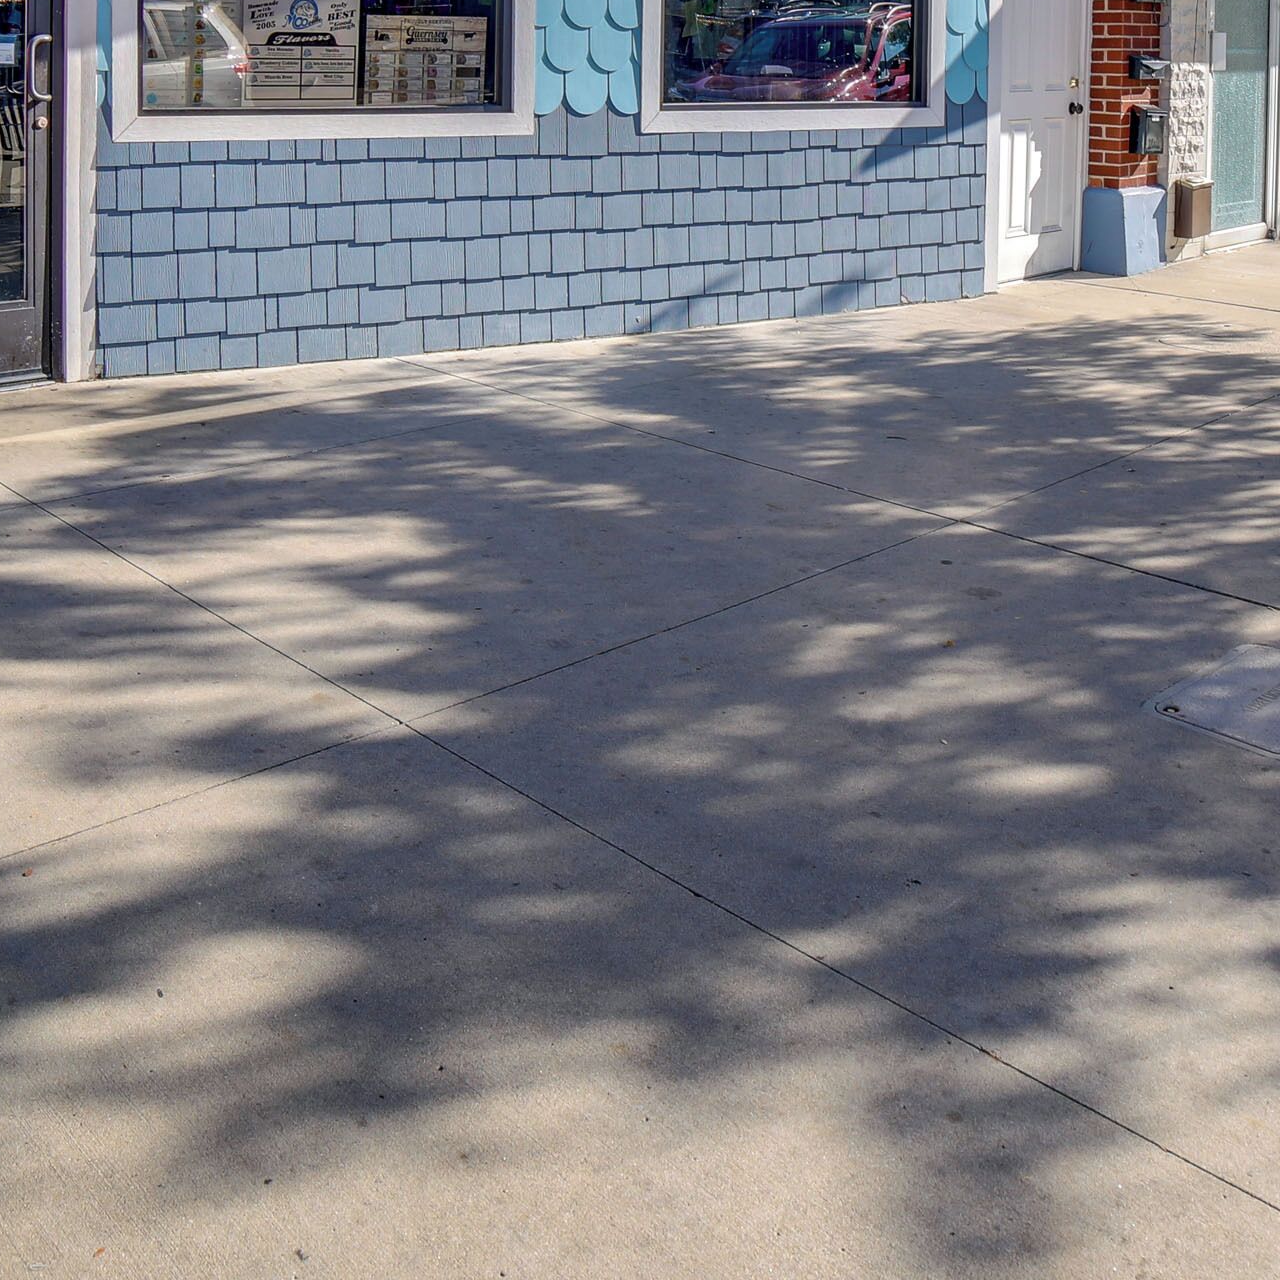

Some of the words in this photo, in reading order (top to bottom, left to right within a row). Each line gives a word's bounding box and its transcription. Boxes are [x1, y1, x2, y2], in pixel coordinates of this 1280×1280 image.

[327, 9, 356, 22] BEST
[273, 33, 332, 45] Flavors
[406, 26, 448, 40] Guernsey
